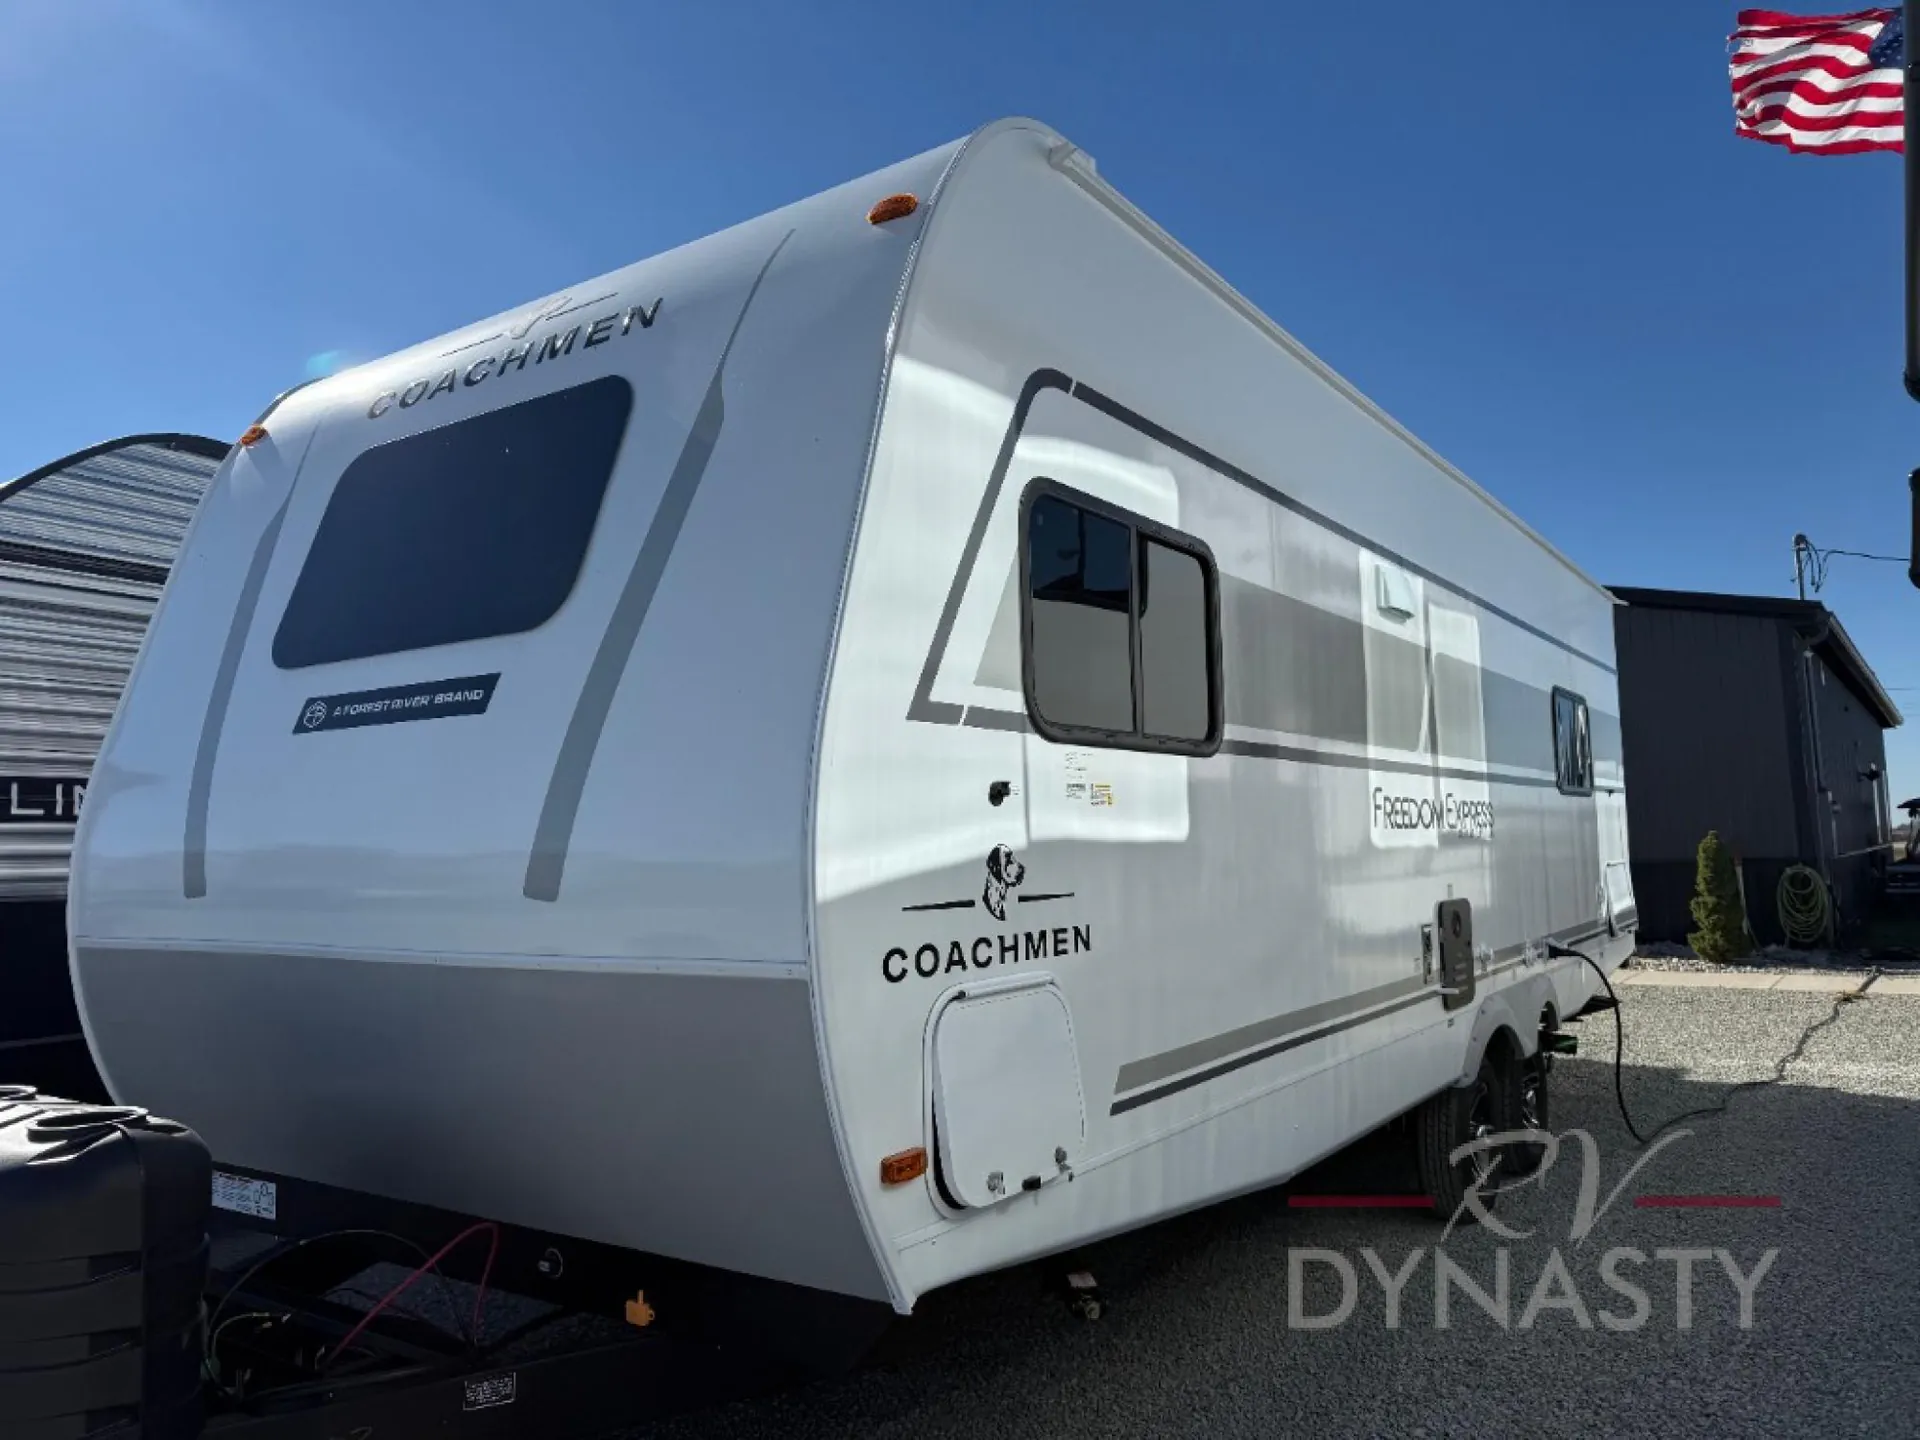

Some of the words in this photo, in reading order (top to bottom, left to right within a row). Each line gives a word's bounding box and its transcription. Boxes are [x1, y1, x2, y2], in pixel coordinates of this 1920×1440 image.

[367, 297, 663, 419] COACHMEN
[343, 700, 390, 715] FOREST
[434, 689, 484, 704] BRAND
[1373, 786, 1444, 829] FREEDOM
[1445, 793, 1495, 829] EXPRESS
[882, 924, 1092, 983] COACHMEN
